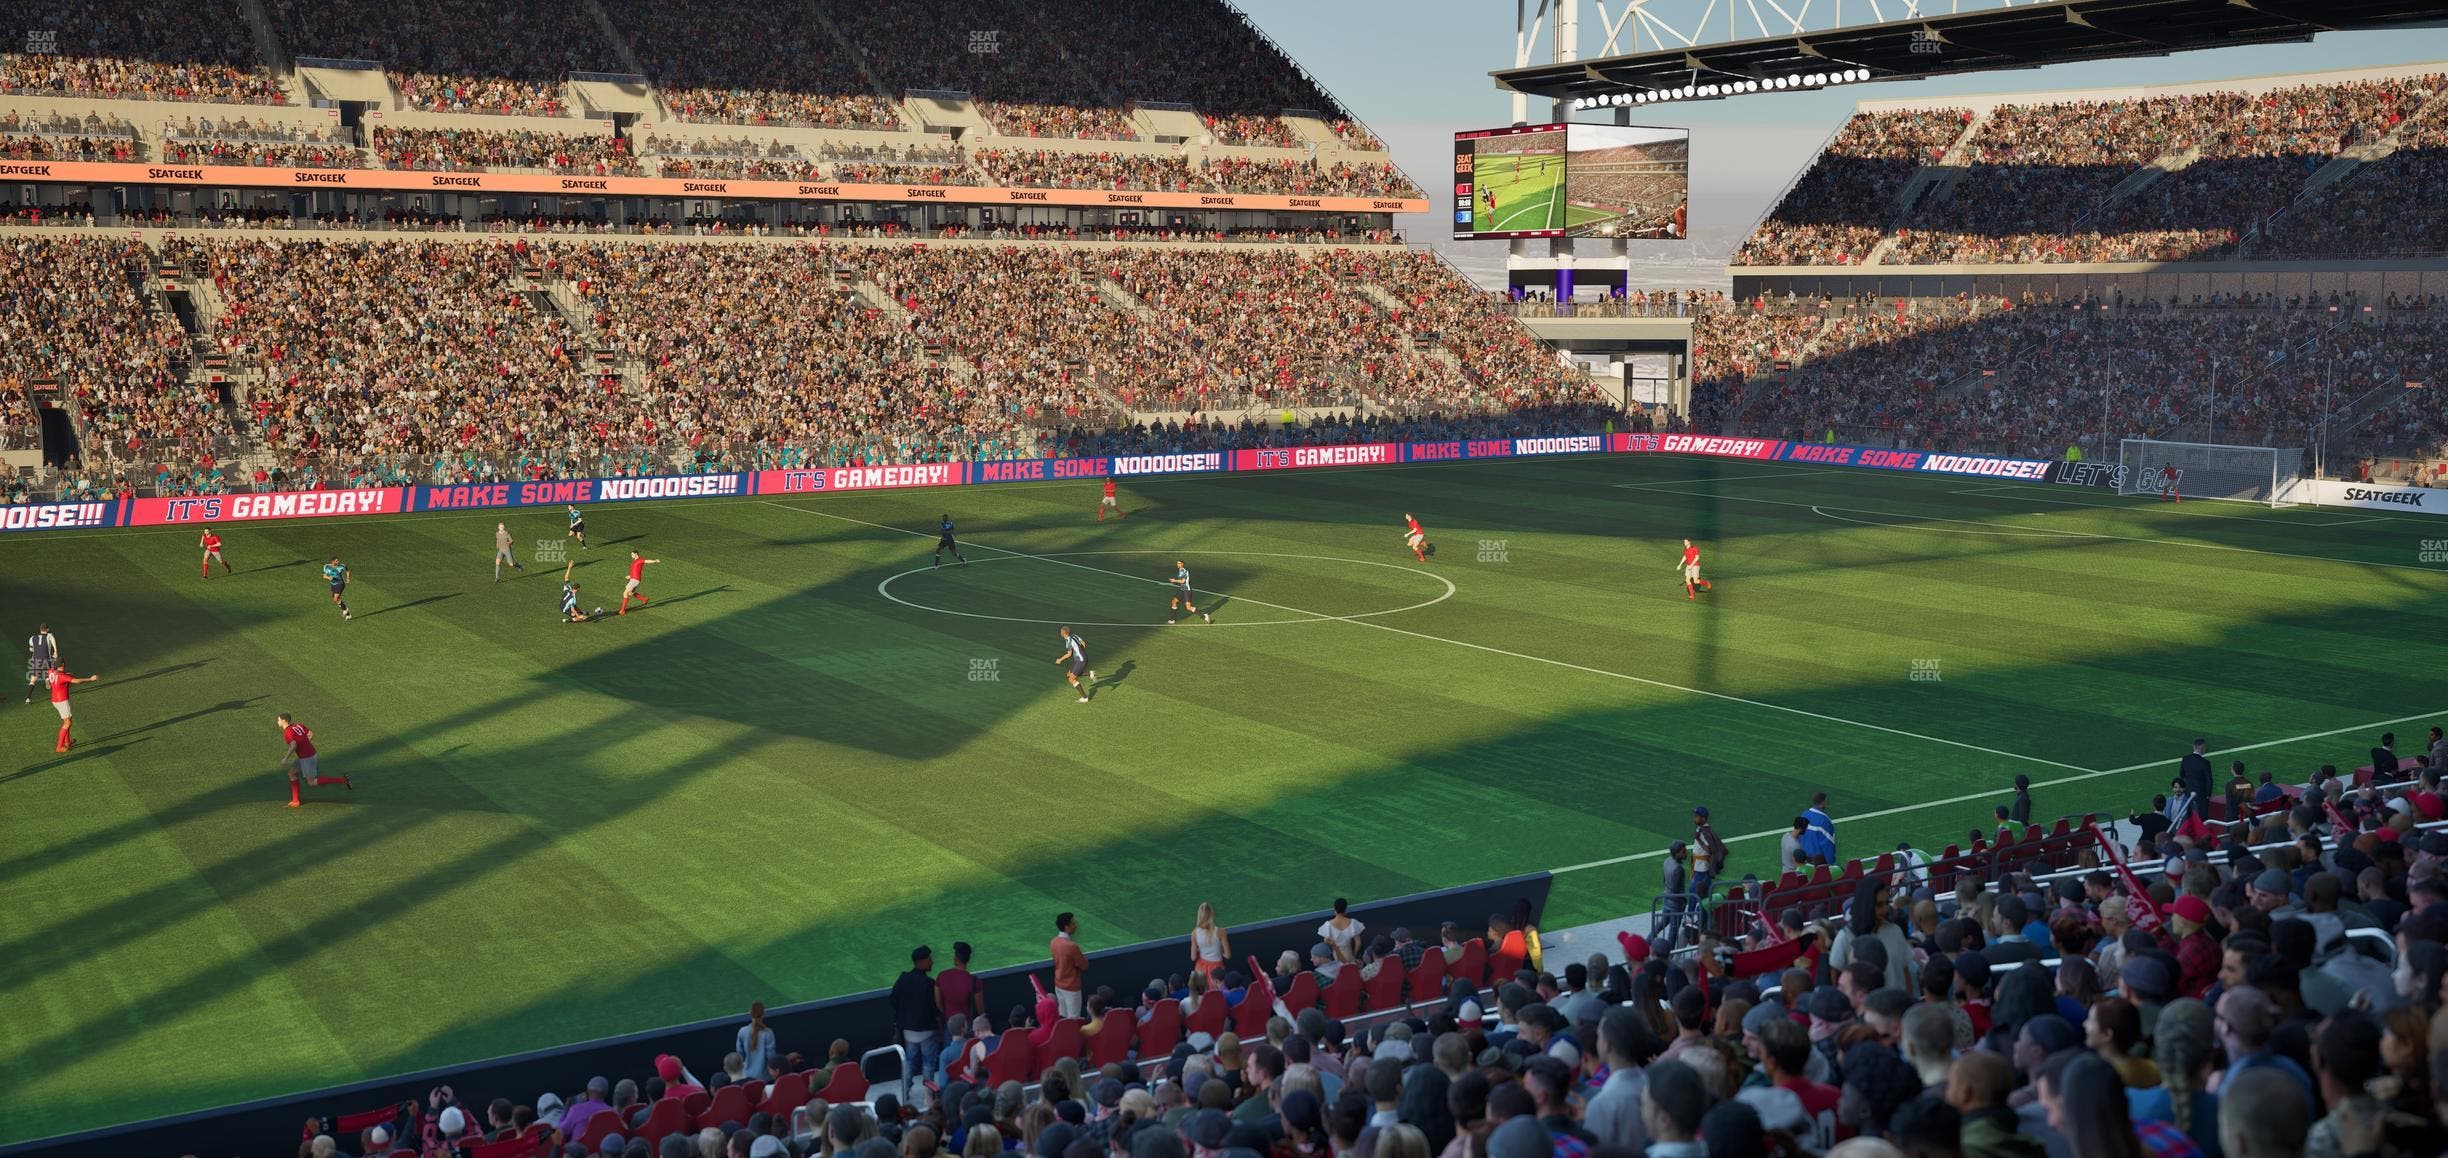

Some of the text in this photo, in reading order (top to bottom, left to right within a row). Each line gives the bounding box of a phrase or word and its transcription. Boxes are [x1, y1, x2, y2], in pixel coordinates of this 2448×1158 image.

[1457, 154, 1472, 164] SEAT
[0, 164, 50, 176] EATGEEK
[1456, 163, 1472, 173] GEEK
[149, 168, 203, 180] SEATGEEK
[295, 172, 346, 183] SEATGEEK
[432, 176, 481, 187] SEATGEEK
[561, 179, 607, 190] SEATGEEK
[683, 182, 727, 193] SEATGEEK
[798, 185, 839, 196] SEATGEEK
[907, 188, 946, 198] SEATGEEK
[1010, 191, 1047, 201] SEATGEEK
[1108, 194, 1143, 203] SEATGEEK
[1200, 196, 1234, 206] SEATGEEK
[1289, 199, 1321, 208] SEATGEEK
[1373, 201, 1404, 210] SEATGEEK
[1412, 435, 1600, 460] MAKE SOME NOOOOISE!!!
[1627, 434, 1765, 456] IT'S GAMEDAY!
[1256, 445, 1386, 468] IT'S GAMEDAY!
[1789, 445, 2053, 479] MAKE SOME NOOOOISE!!
[983, 452, 1221, 481] MAKE SOME NOOOOISE!!!
[784, 465, 949, 491] IT'S GAMEDAY!
[2056, 461, 2129, 488] LET'S
[428, 474, 737, 509] MAKE SOME NOOOOISE!!!
[2344, 488, 2425, 506] SEATGEEK
[166, 490, 384, 521] IT'S GAMEDAY!
